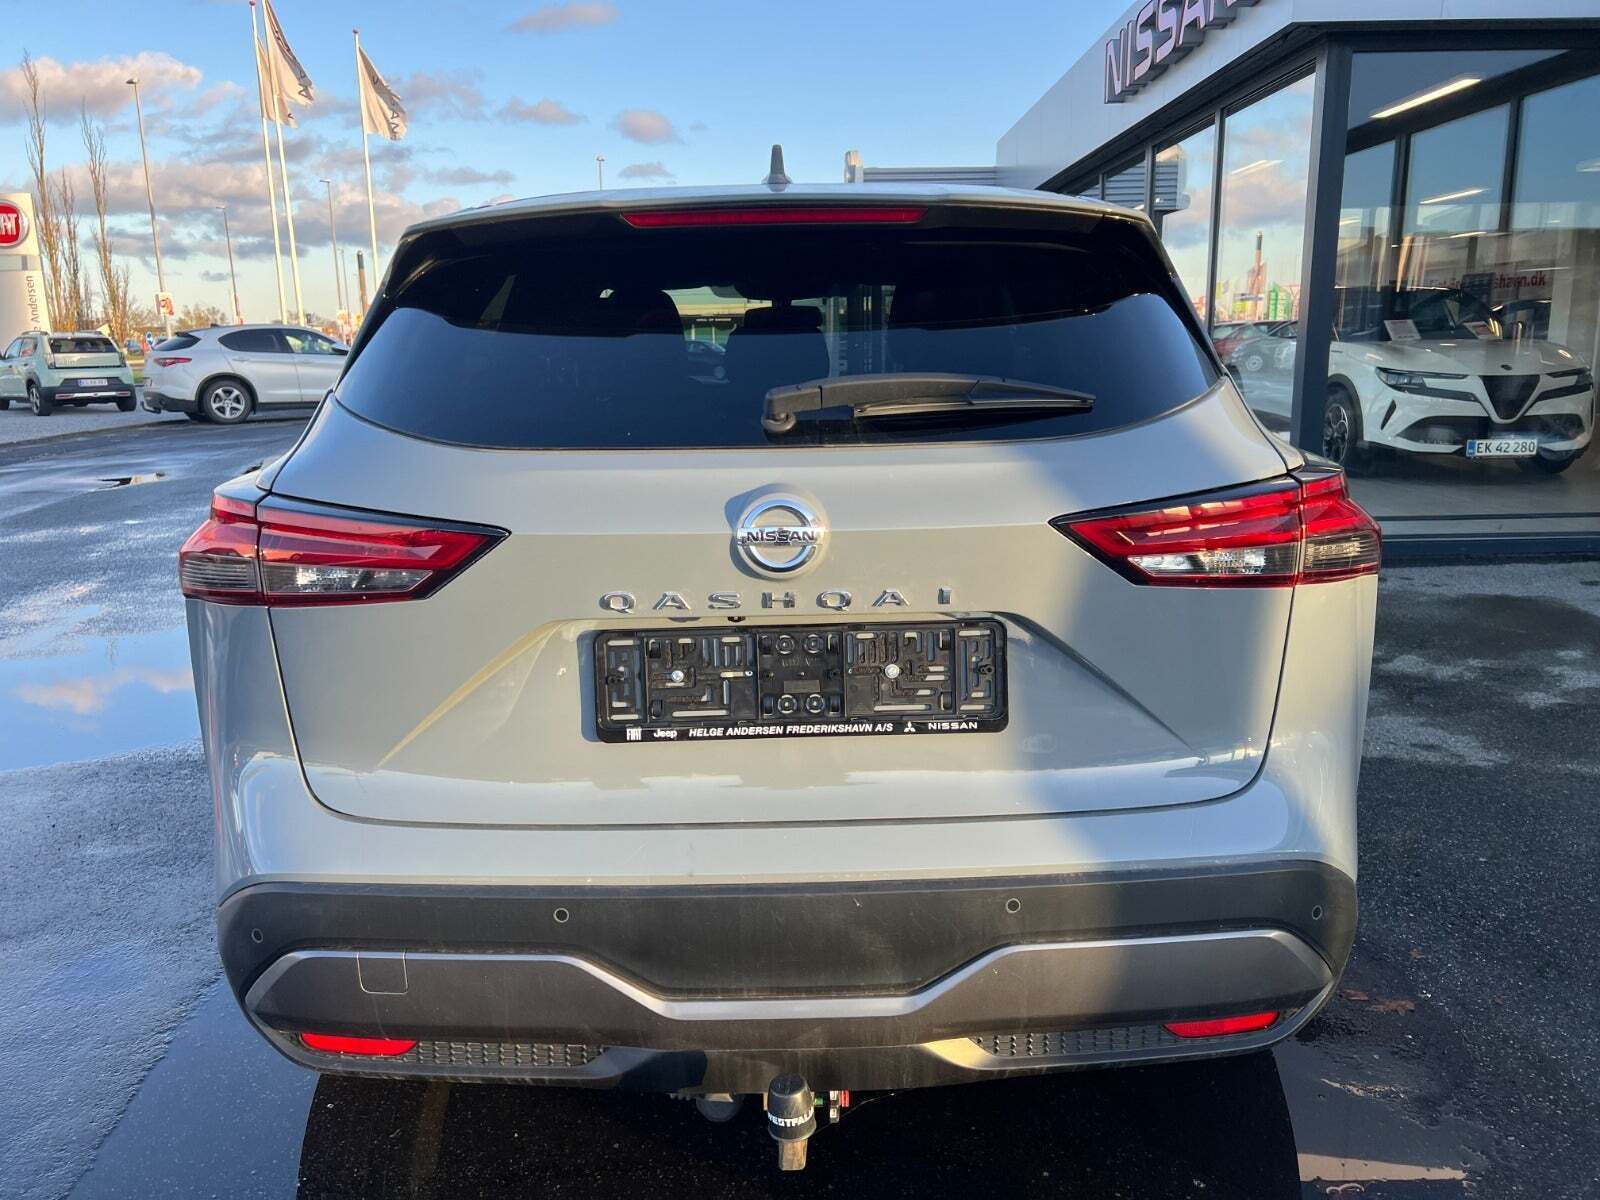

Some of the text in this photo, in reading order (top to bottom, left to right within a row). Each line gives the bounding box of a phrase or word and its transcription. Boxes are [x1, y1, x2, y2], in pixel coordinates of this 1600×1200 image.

[0, 212, 18, 236] AT
[25, 275, 41, 323] Andersen
[1477, 441, 1535, 453] EK 42 280
[746, 530, 816, 542] NISSAN
[599, 586, 952, 614] QASHQAI
[688, 722, 894, 738] HELGE ANDERSEN FREDERIKSHAVN A/S
[928, 721, 978, 730] NISSAN
[626, 727, 642, 741] FIAT
[653, 728, 678, 739] Jeep
